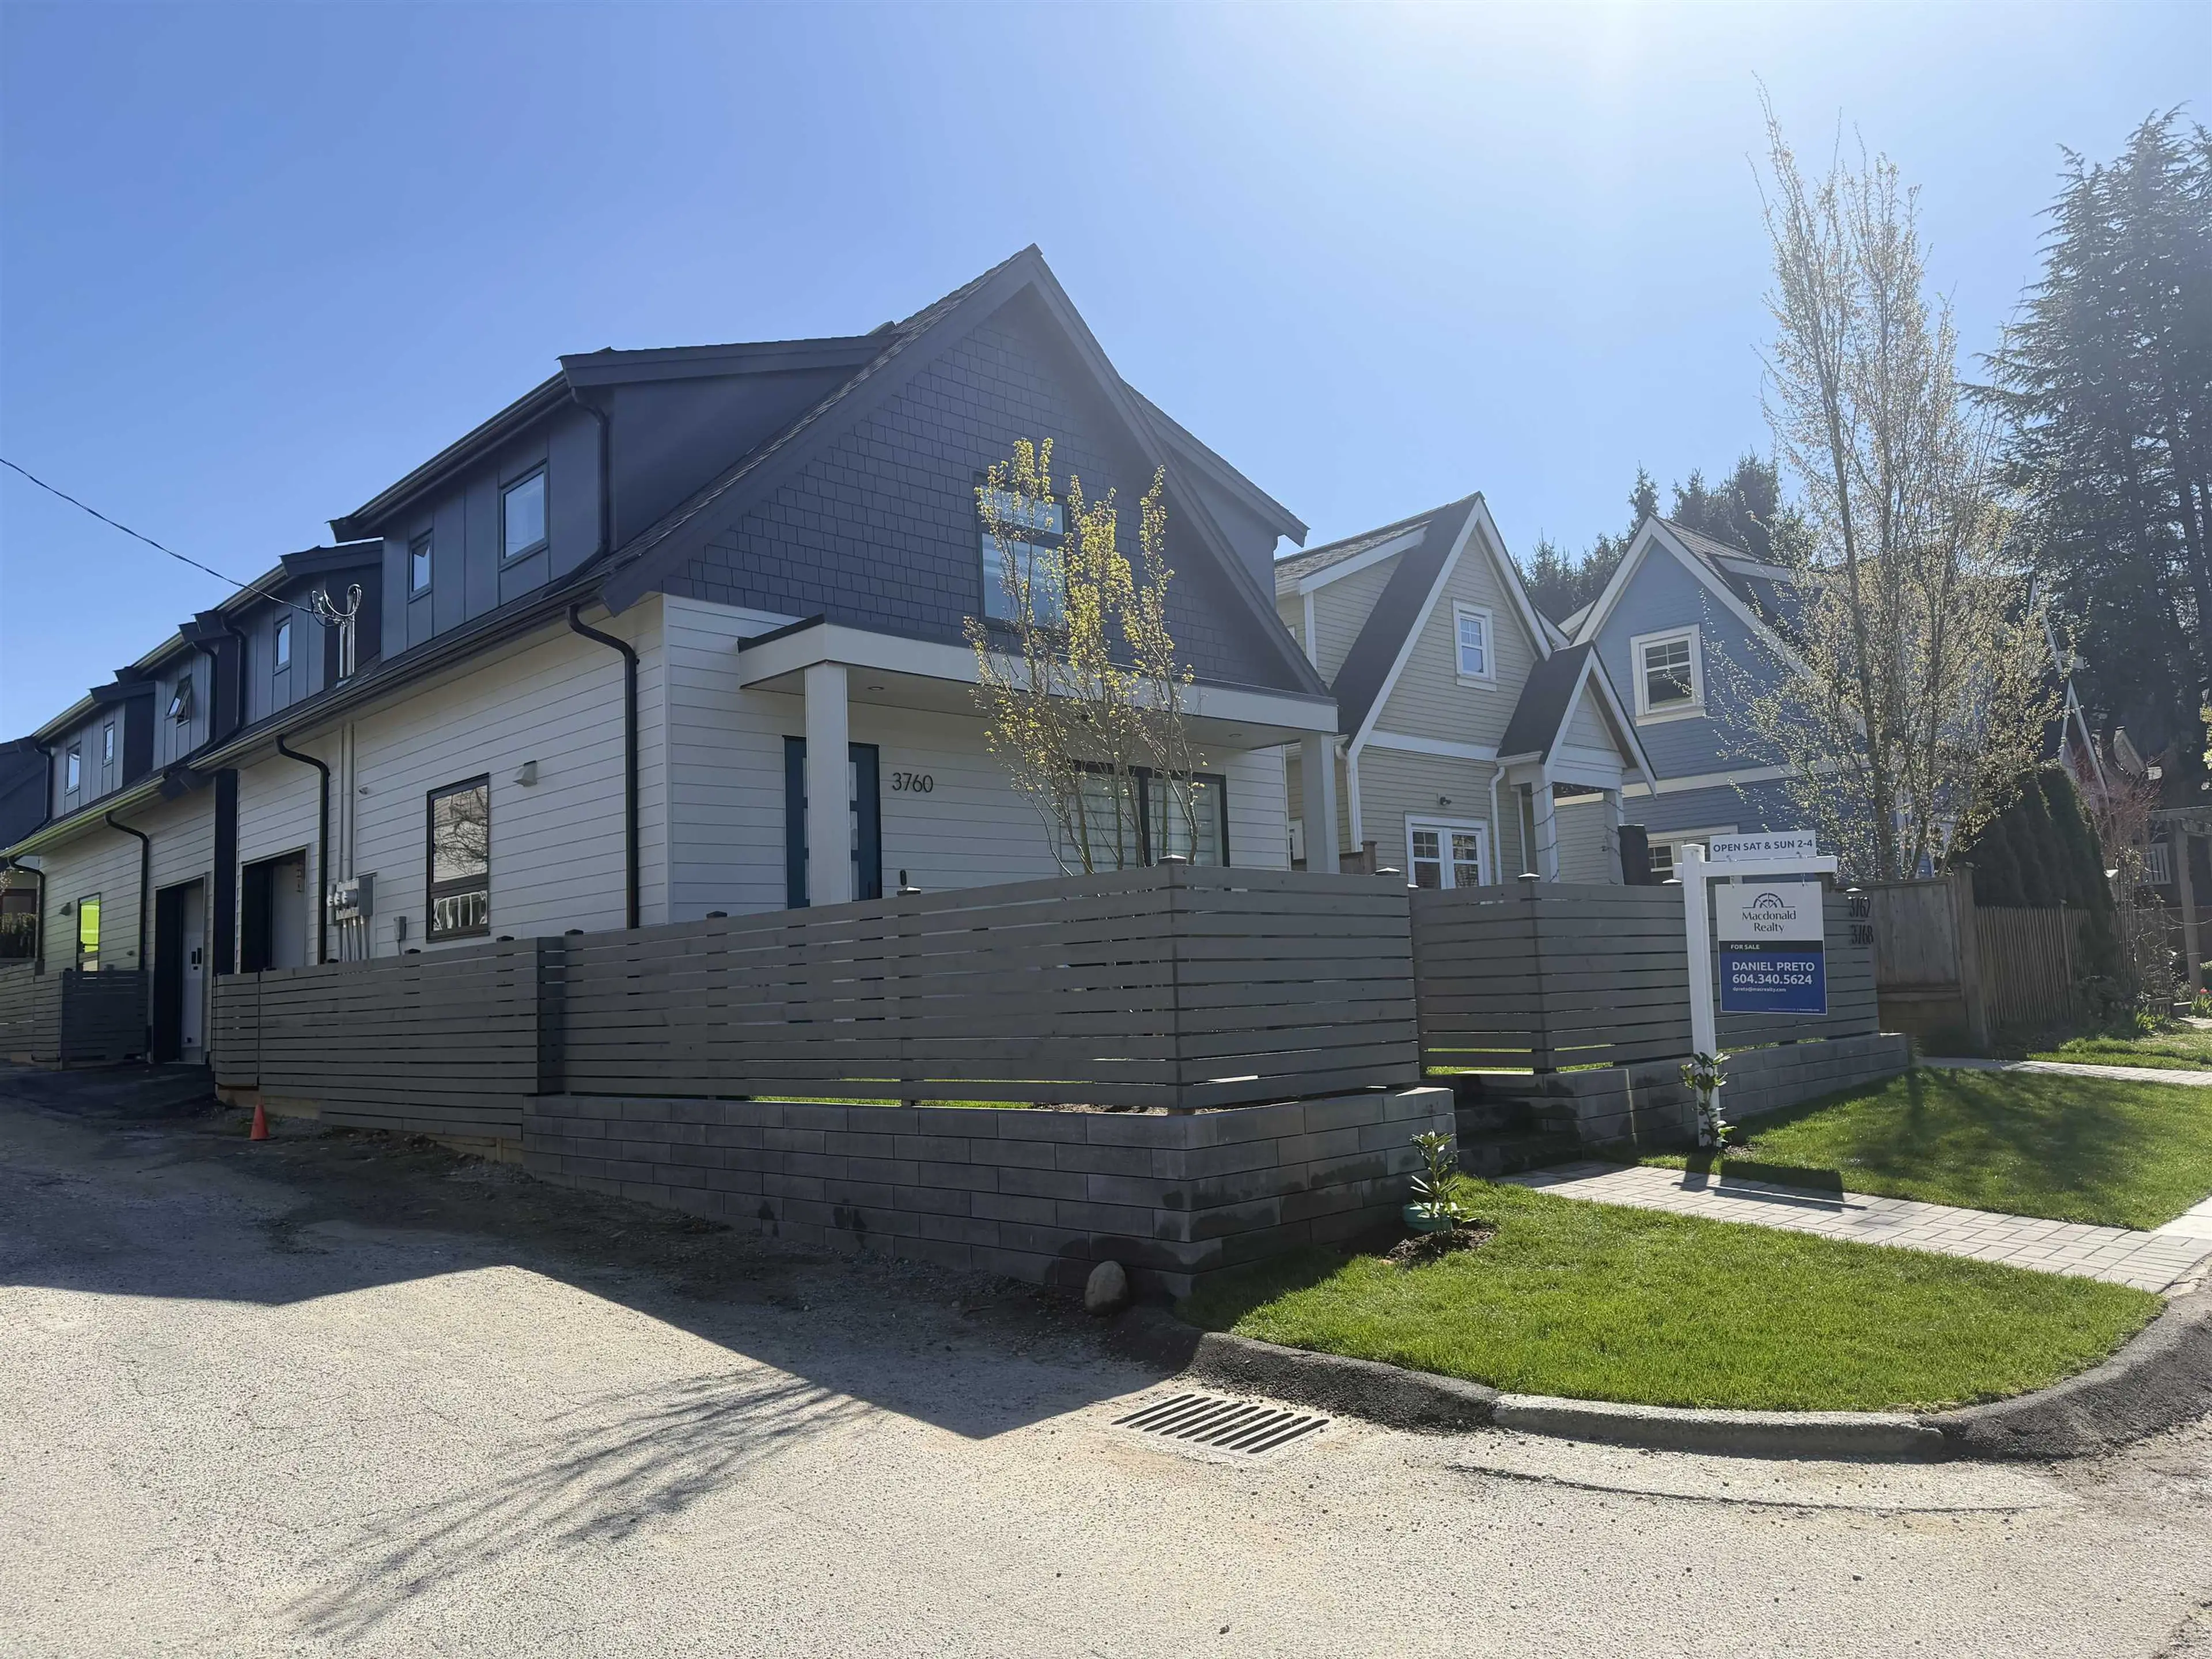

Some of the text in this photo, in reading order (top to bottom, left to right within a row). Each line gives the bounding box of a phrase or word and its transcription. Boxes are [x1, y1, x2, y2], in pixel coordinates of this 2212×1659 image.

[892, 772, 933, 793] 3760
[1713, 839, 1813, 853] OPEN SAT & SUN 2-4
[1741, 910, 1797, 920] Macdonald
[1753, 922, 1785, 934] Realty
[1732, 961, 1815, 972] DANIEL PRETO
[1732, 974, 1813, 984] 604.340.5624
